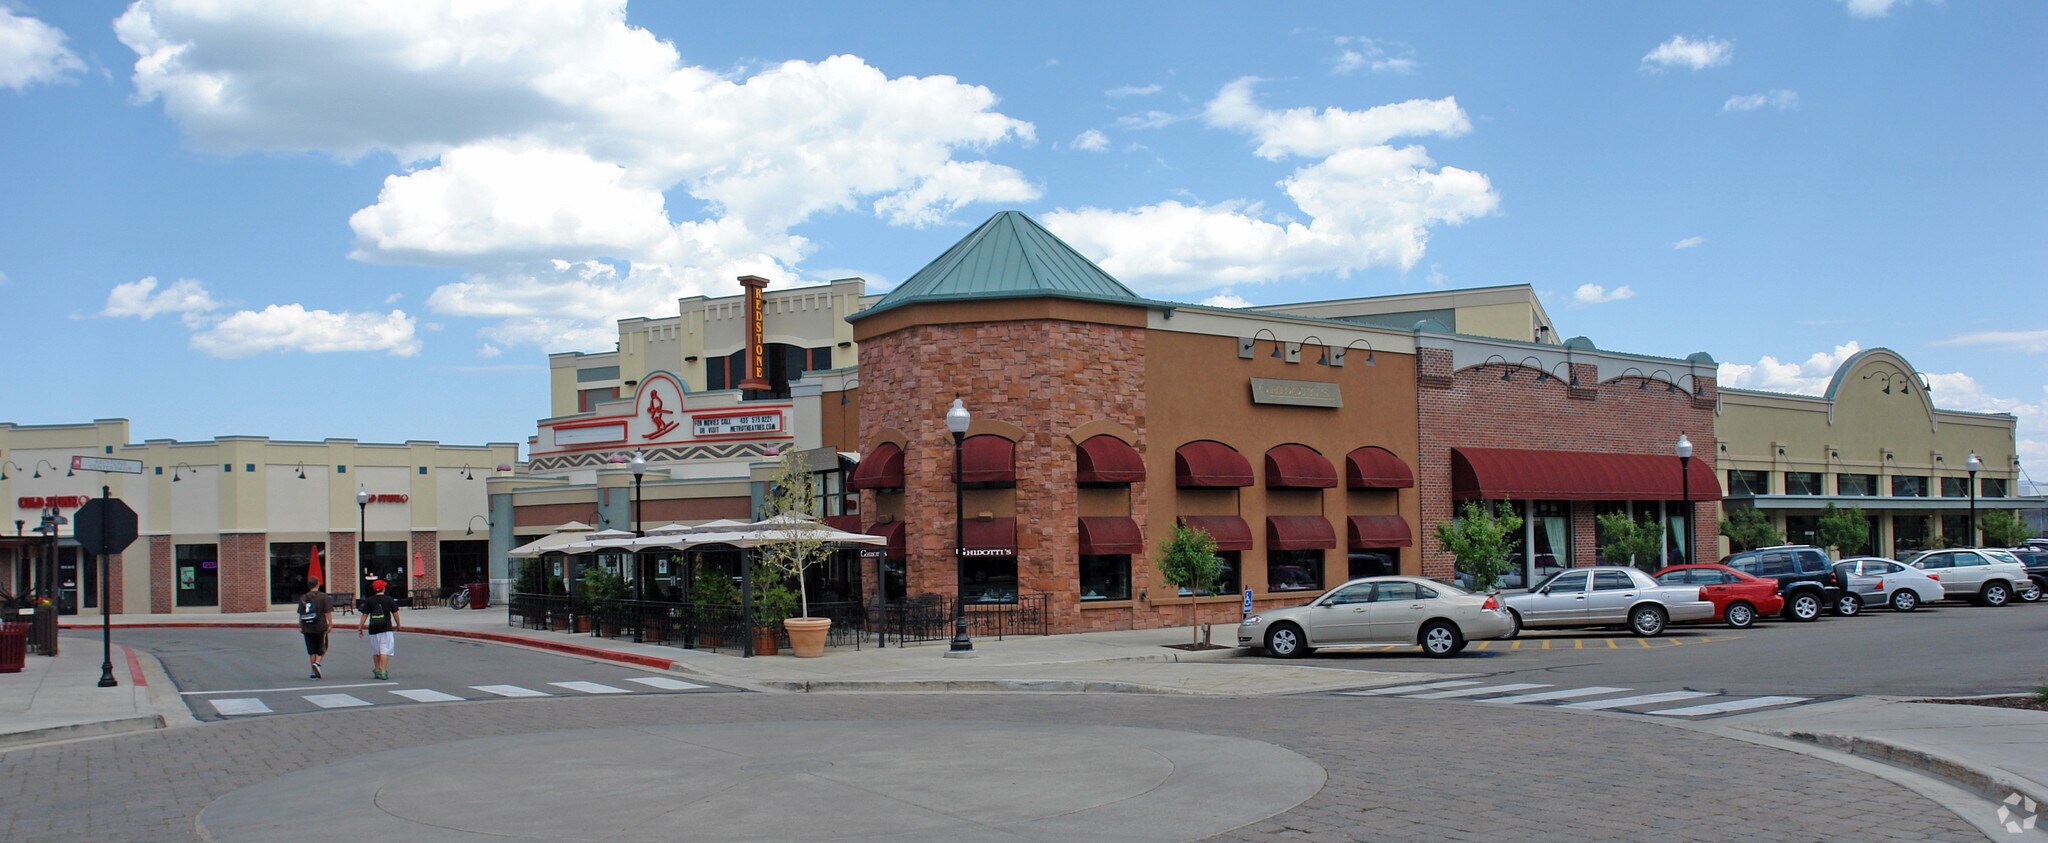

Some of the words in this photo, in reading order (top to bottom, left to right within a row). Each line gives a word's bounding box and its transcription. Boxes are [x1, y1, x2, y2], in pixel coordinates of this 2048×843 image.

[755, 288, 763, 378] REDSTONE
[704, 418, 719, 426] MOVIES
[740, 416, 748, 424] 435
[18, 497, 45, 509] COLD
